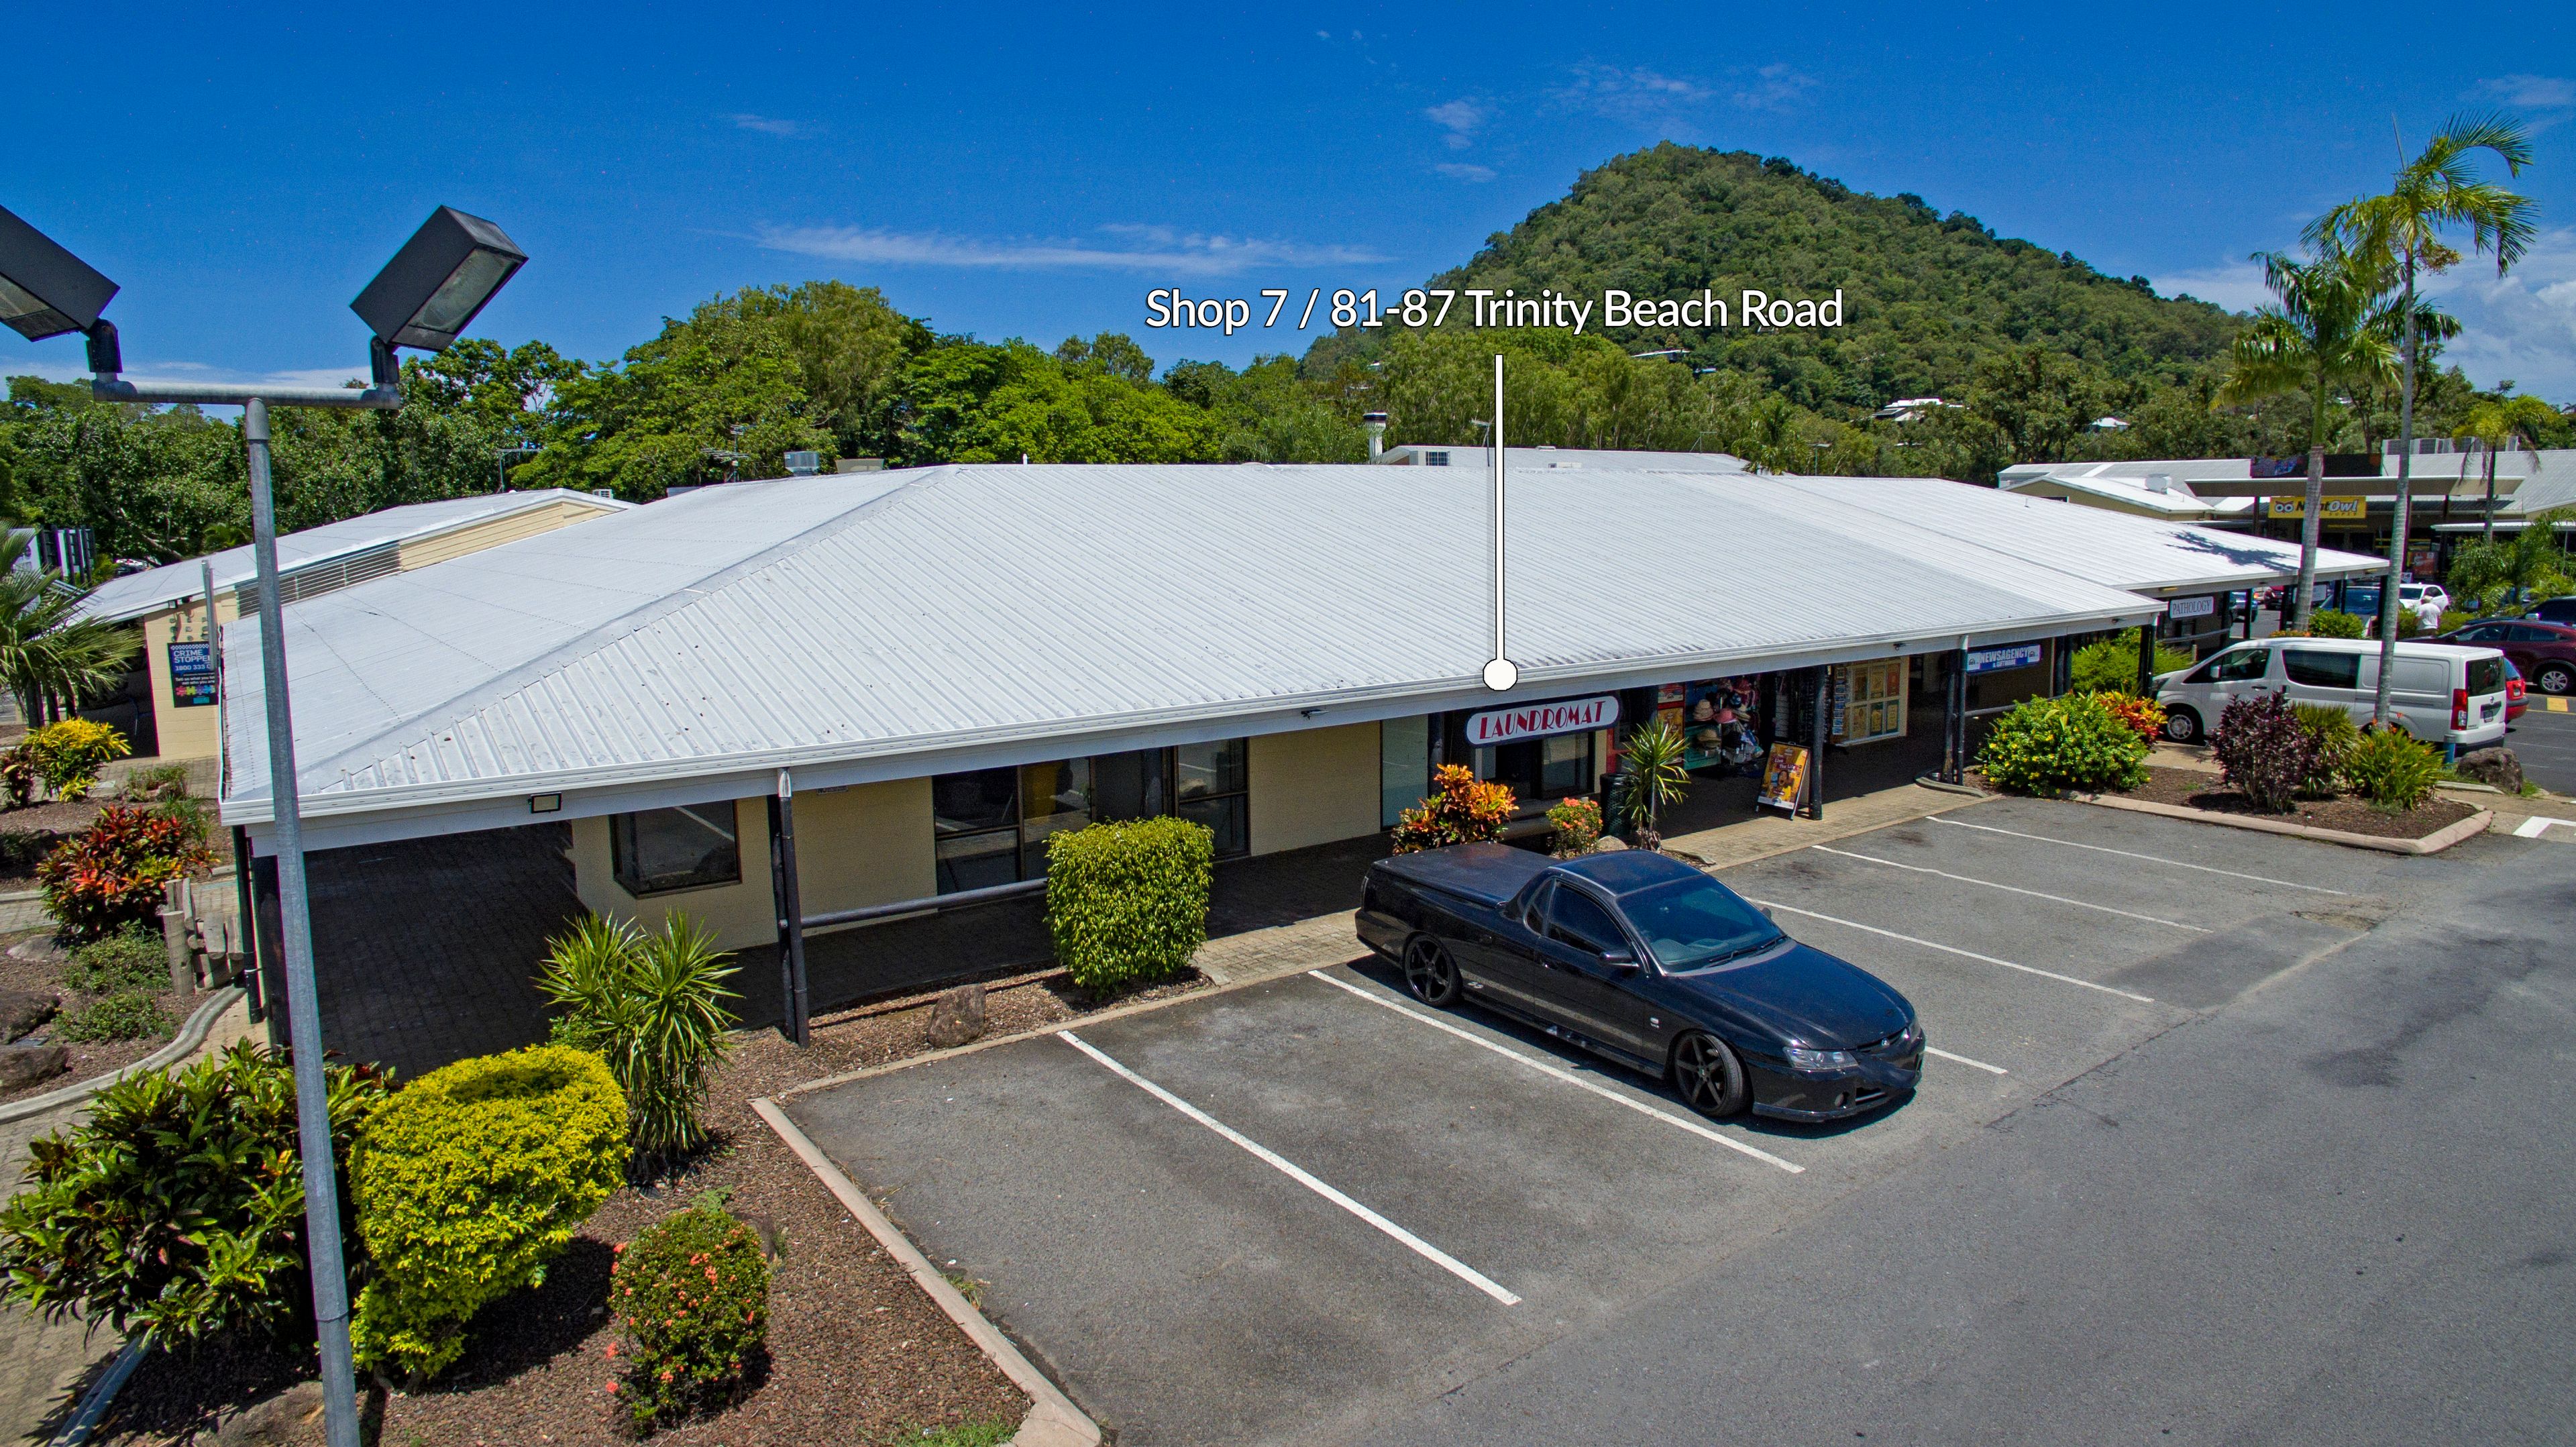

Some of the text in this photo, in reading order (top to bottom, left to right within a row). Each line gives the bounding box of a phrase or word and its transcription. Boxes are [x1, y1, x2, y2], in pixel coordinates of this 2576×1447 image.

[2173, 600, 2212, 615] PATHOLOGY
[174, 655, 211, 663] STOPPE
[1979, 647, 2029, 663] NEWSAGENCY
[1479, 700, 1606, 740] LAUNDROMAT
